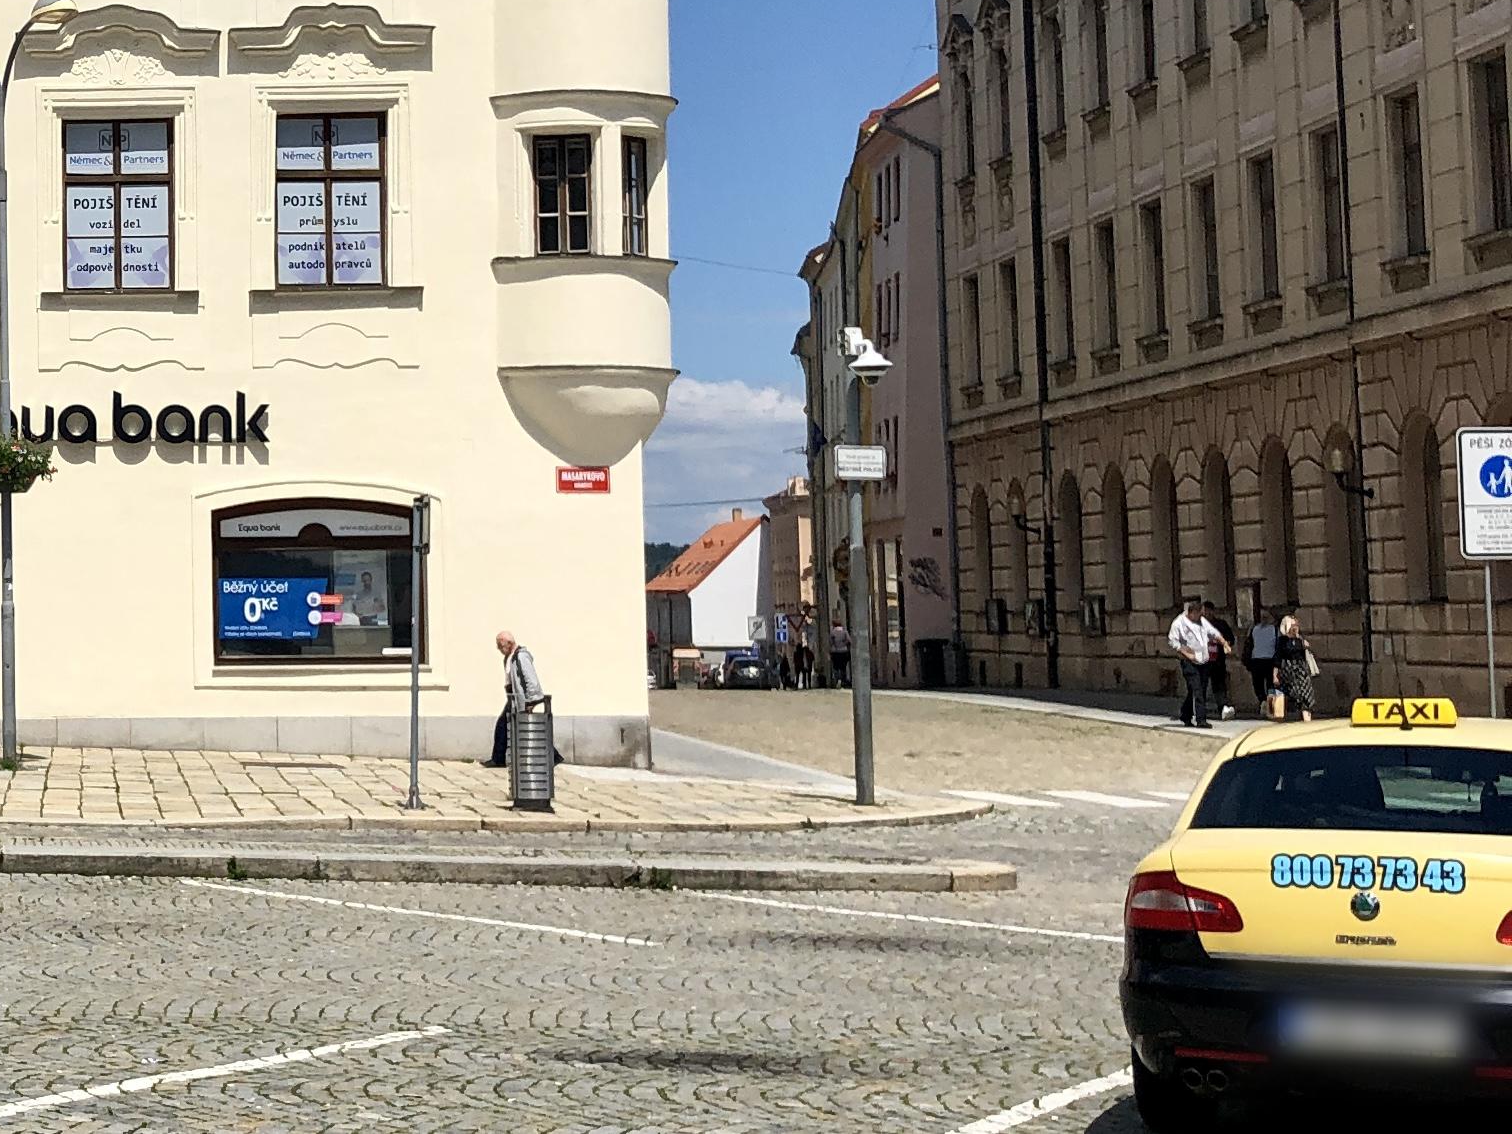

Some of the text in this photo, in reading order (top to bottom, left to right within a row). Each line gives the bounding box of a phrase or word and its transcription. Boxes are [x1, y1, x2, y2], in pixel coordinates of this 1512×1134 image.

[69, 155, 164, 166] Němec & Partners
[282, 151, 315, 160] Němec
[333, 150, 373, 160] Partners
[113, 390, 270, 444] bank
[238, 523, 281, 533] Equa bank
[223, 580, 289, 595] Běžný účet
[1366, 702, 1440, 721] TAXI
[1271, 853, 1466, 895] 800 73 73 43
